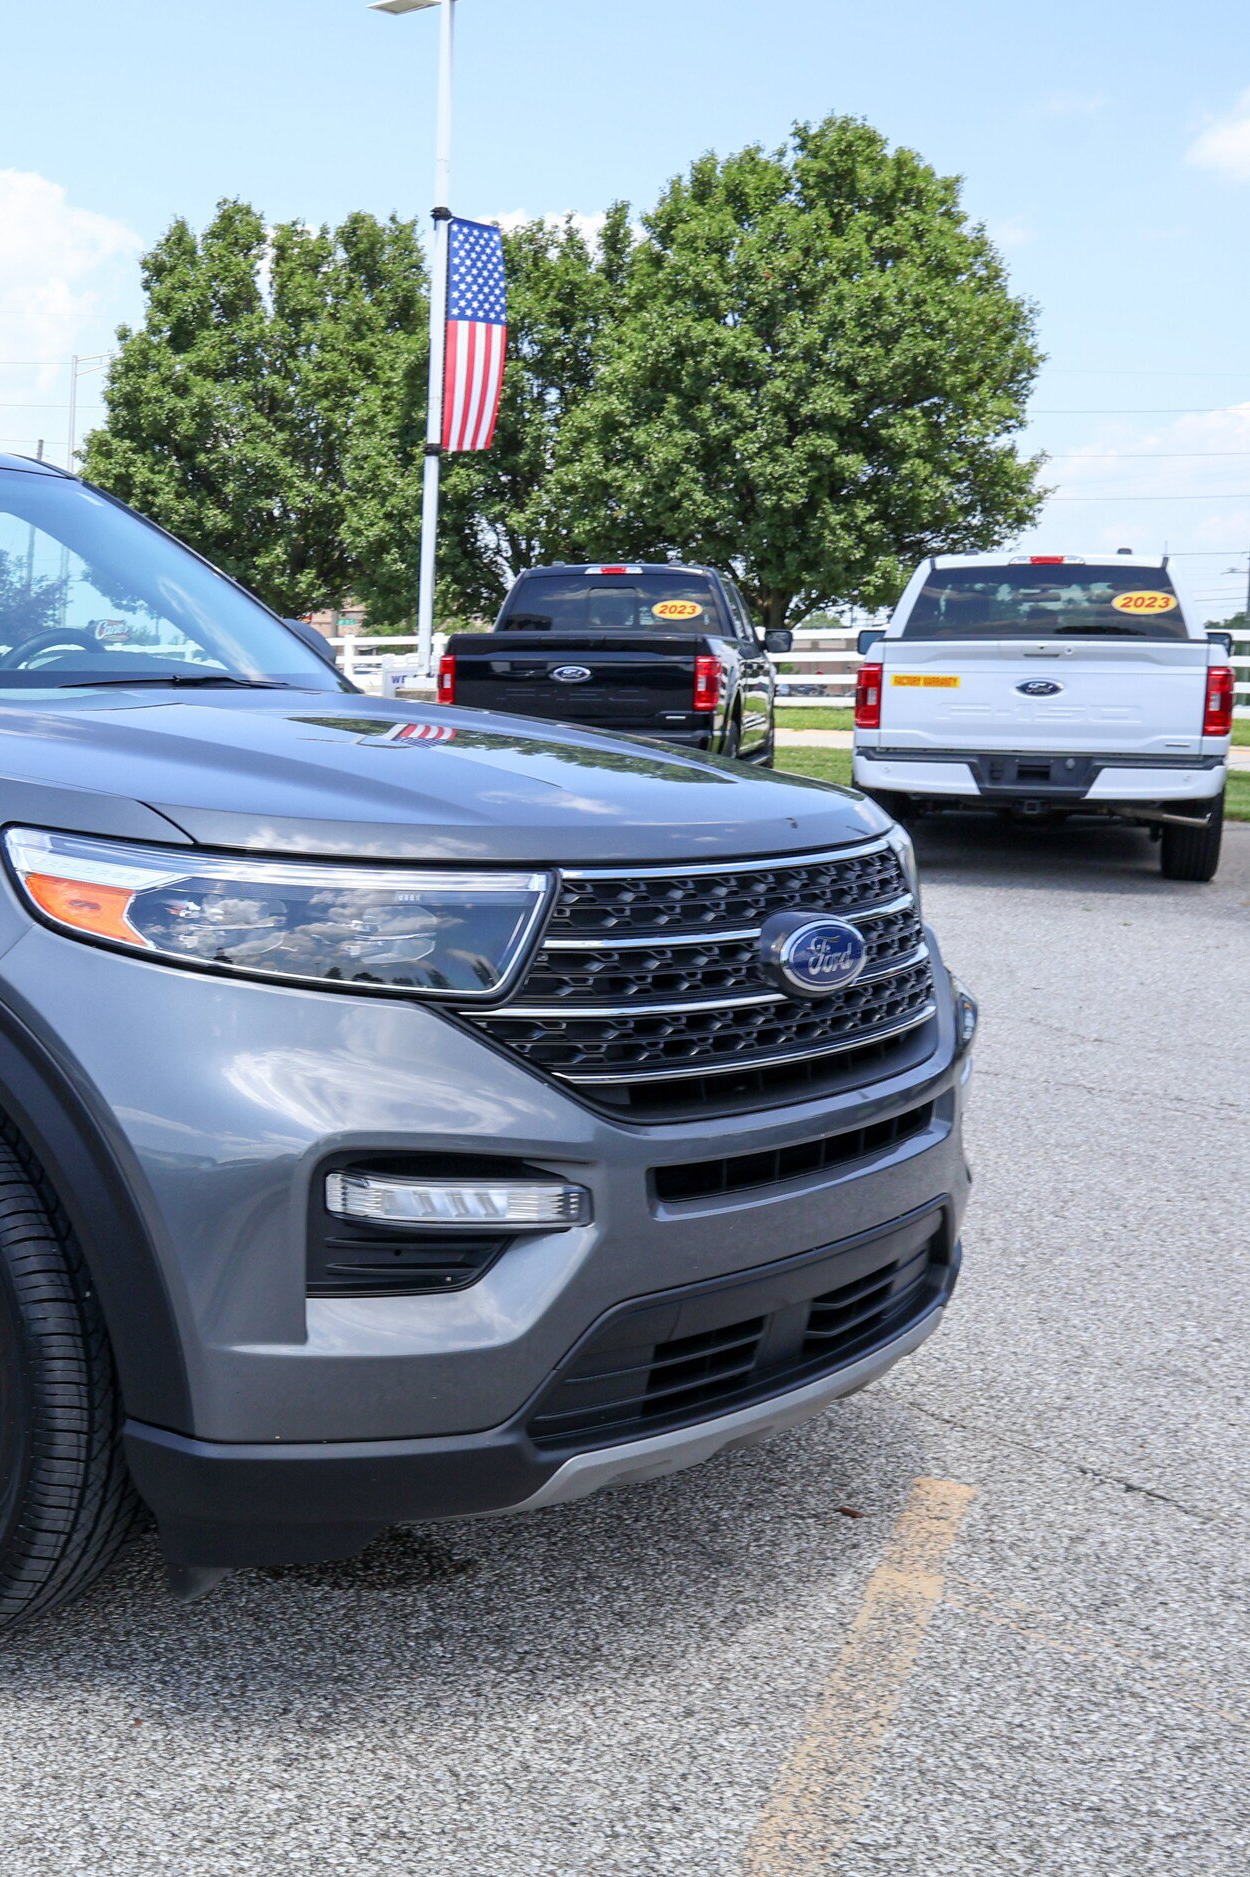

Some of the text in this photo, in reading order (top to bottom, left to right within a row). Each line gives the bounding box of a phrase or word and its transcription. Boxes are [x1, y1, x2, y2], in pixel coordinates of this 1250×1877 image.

[1120, 596, 1171, 609] 2023
[658, 604, 696, 615] 2023
[808, 935, 854, 976] Ford
